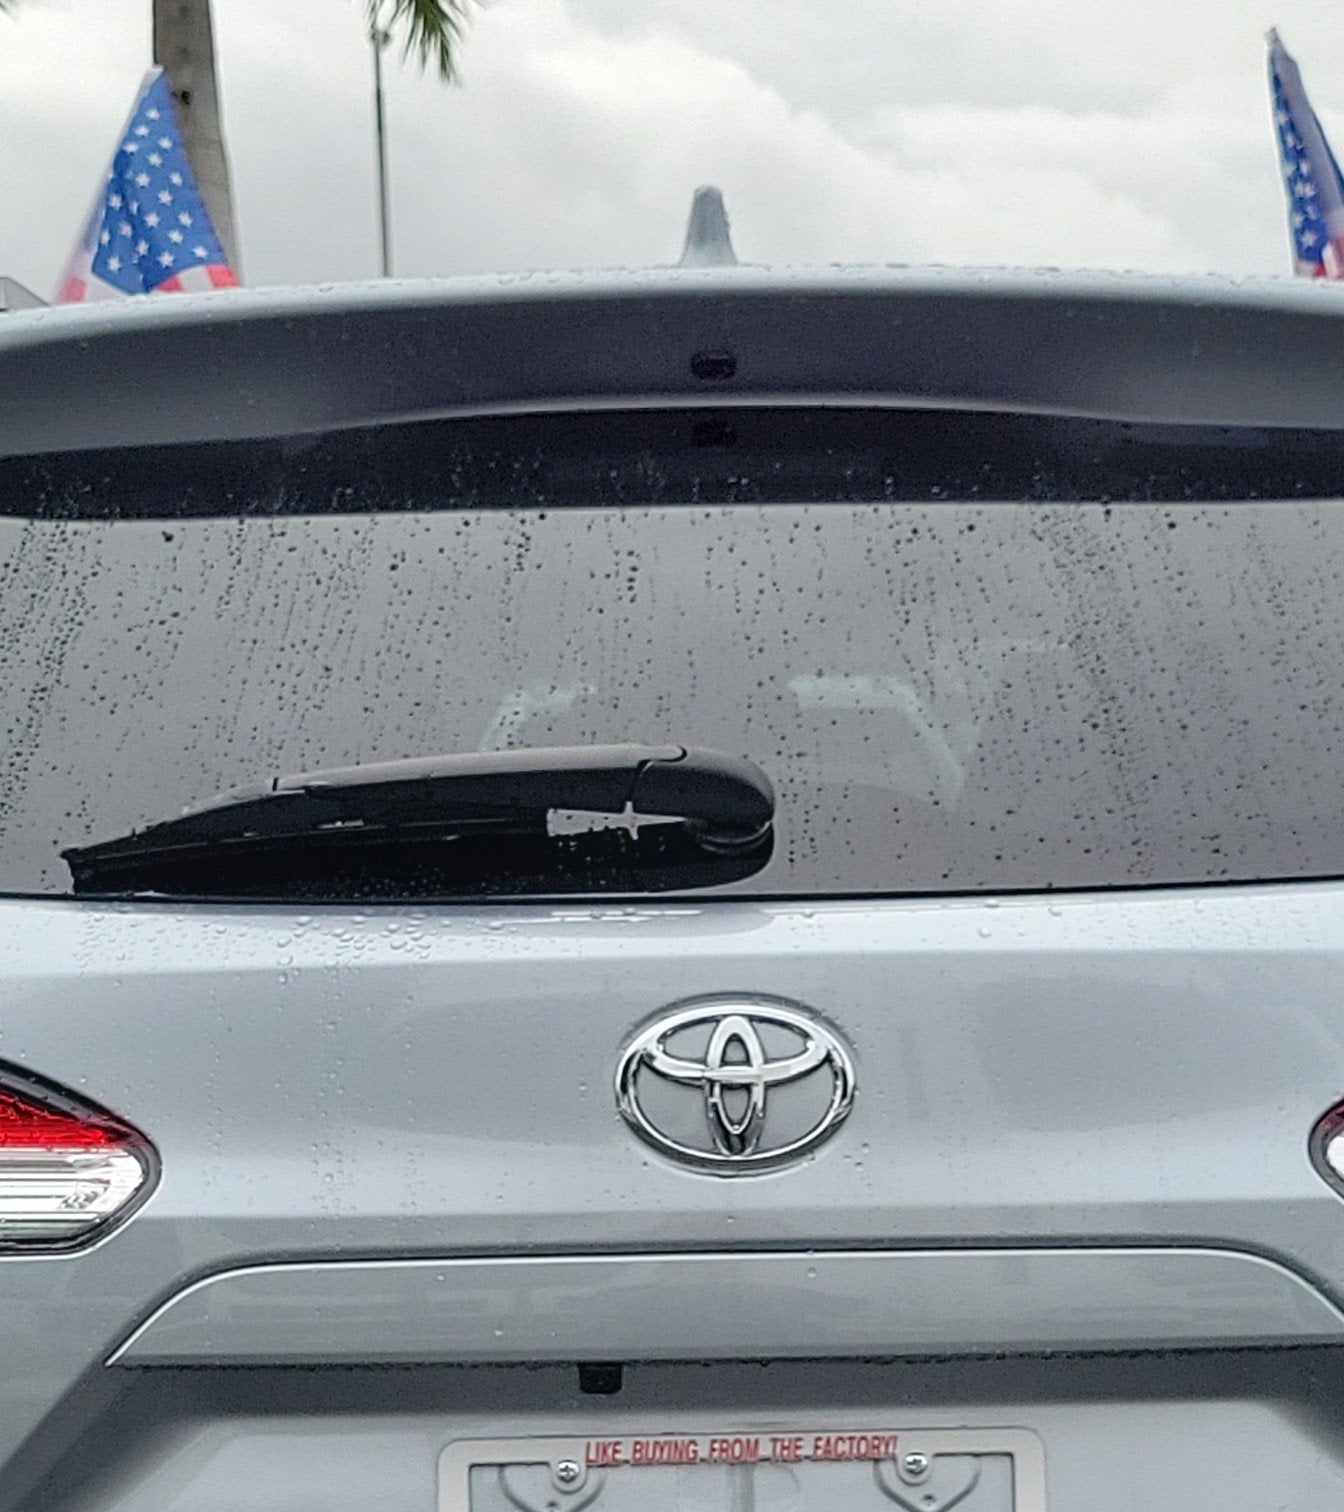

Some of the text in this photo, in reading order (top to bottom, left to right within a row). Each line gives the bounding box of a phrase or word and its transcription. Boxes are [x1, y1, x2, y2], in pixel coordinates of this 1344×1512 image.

[584, 1434, 899, 1464] LIKE BUYING FROM THE FACTORY!
